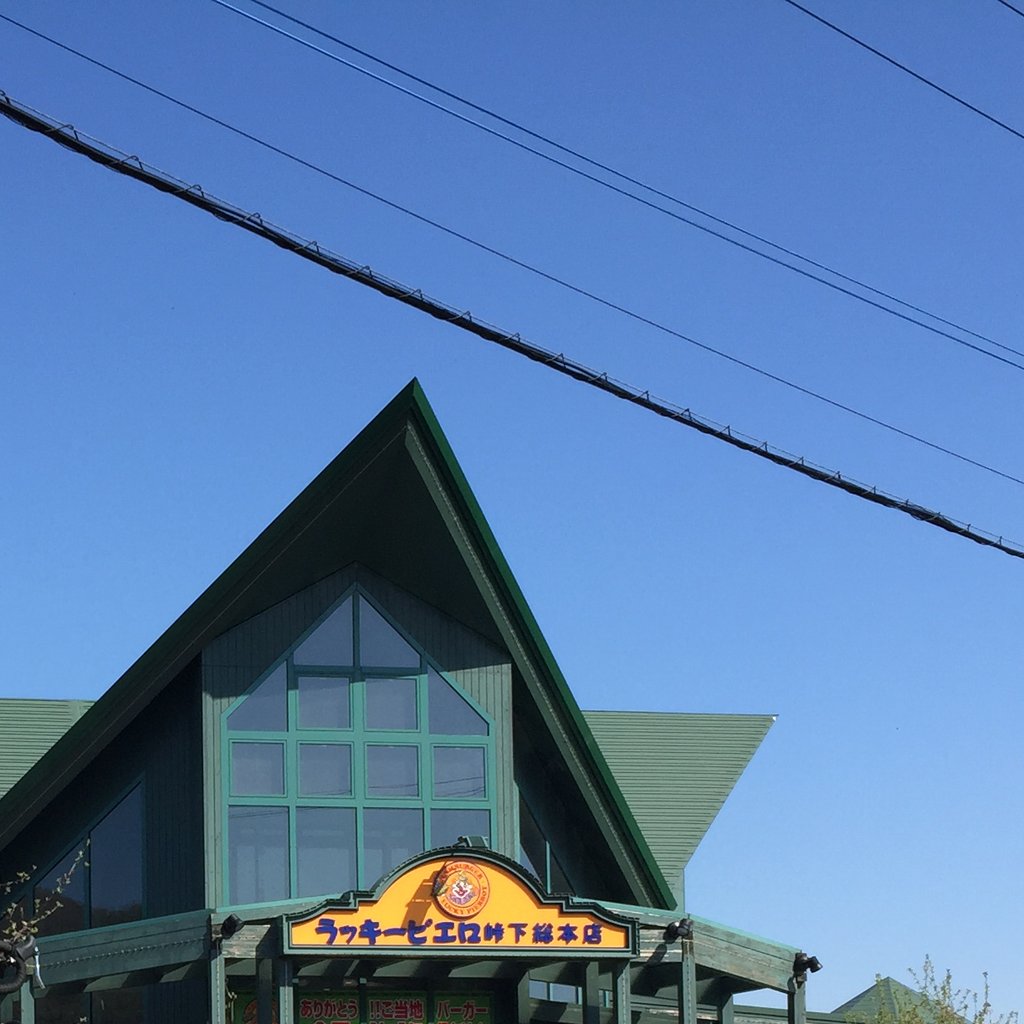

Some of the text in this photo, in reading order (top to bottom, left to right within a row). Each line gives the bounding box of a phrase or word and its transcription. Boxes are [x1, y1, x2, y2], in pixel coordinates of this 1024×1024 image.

[300, 1000, 358, 1018] ありがとう
[437, 1001, 488, 1019] バーガー
